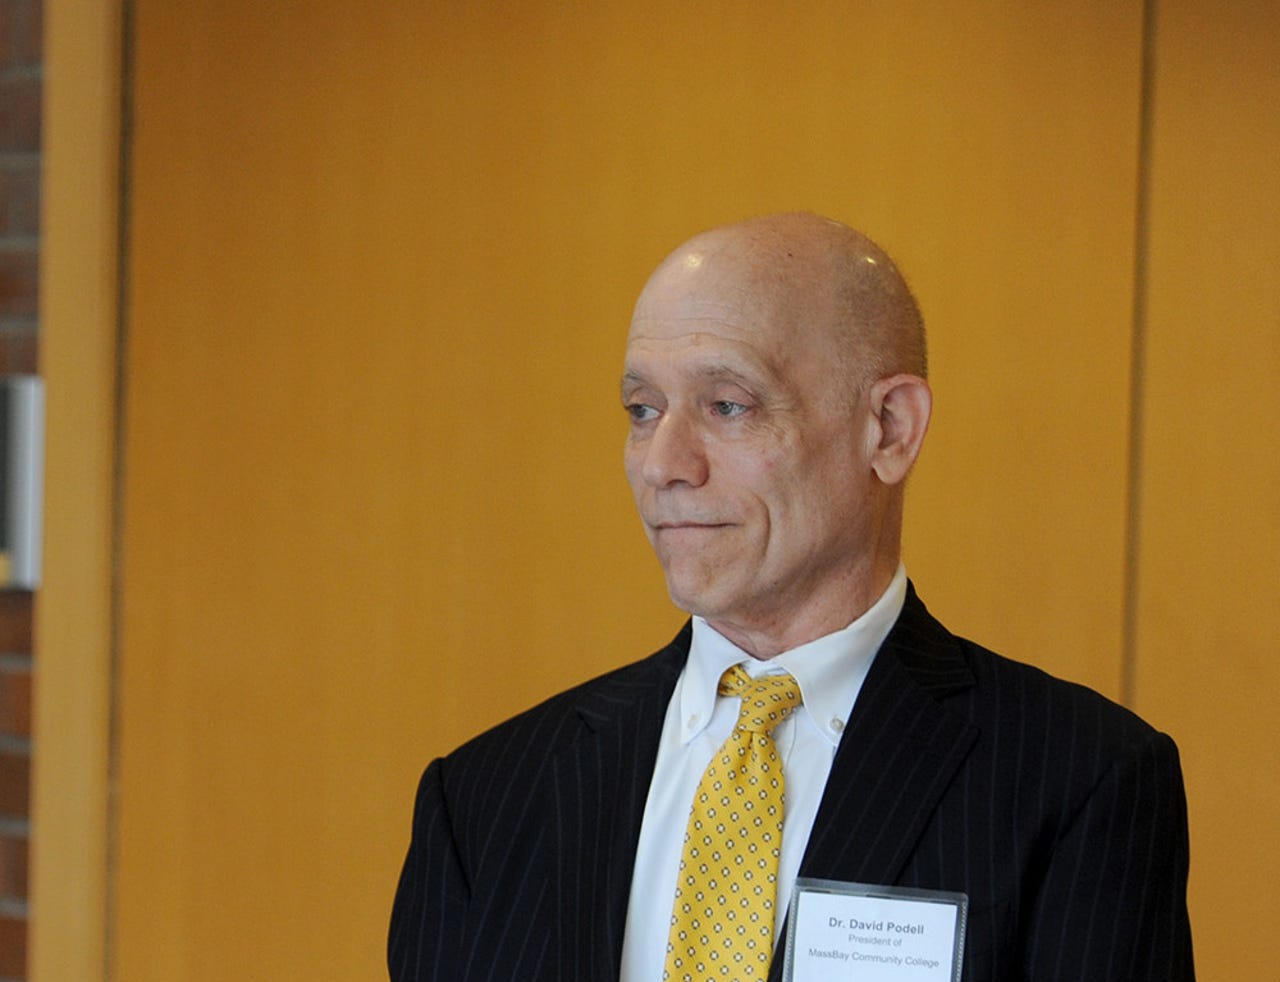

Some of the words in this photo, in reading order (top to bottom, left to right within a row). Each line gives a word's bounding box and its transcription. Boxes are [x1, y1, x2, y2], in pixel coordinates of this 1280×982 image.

[828, 917, 846, 928] Dr.
[849, 918, 883, 931] David
[886, 922, 924, 935] Podell
[848, 933, 891, 946] President
[892, 938, 903, 947] of
[808, 948, 850, 961] MassBay
[851, 951, 903, 966] Community
[904, 956, 940, 968] College
